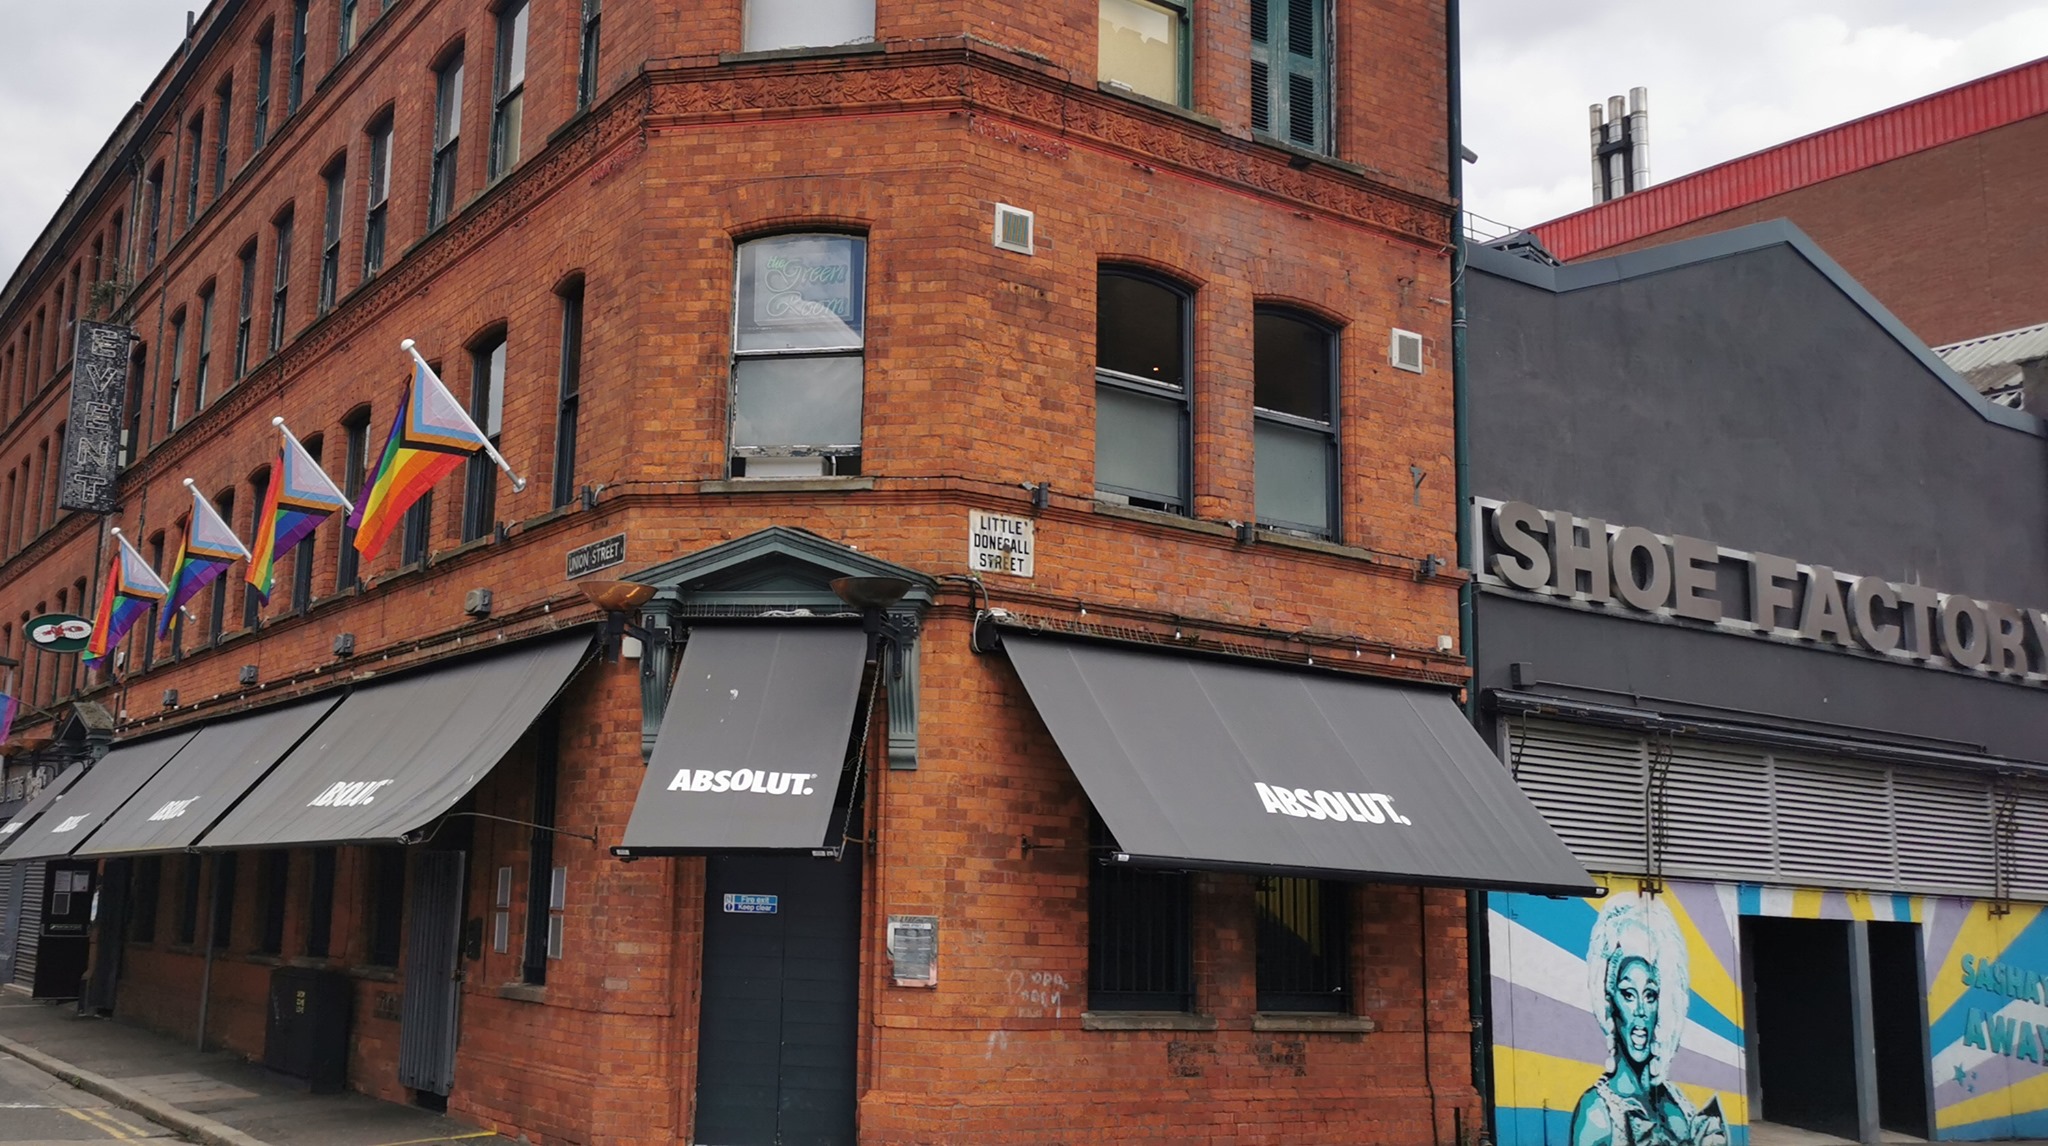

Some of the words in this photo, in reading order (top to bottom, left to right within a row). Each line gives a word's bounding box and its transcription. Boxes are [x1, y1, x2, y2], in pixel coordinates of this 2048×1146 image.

[73, 327, 119, 504] EVENT
[980, 515, 1023, 536] LITTLE
[592, 541, 620, 565] STREET
[979, 552, 1025, 573] STREET
[1491, 500, 1723, 624] SHOE
